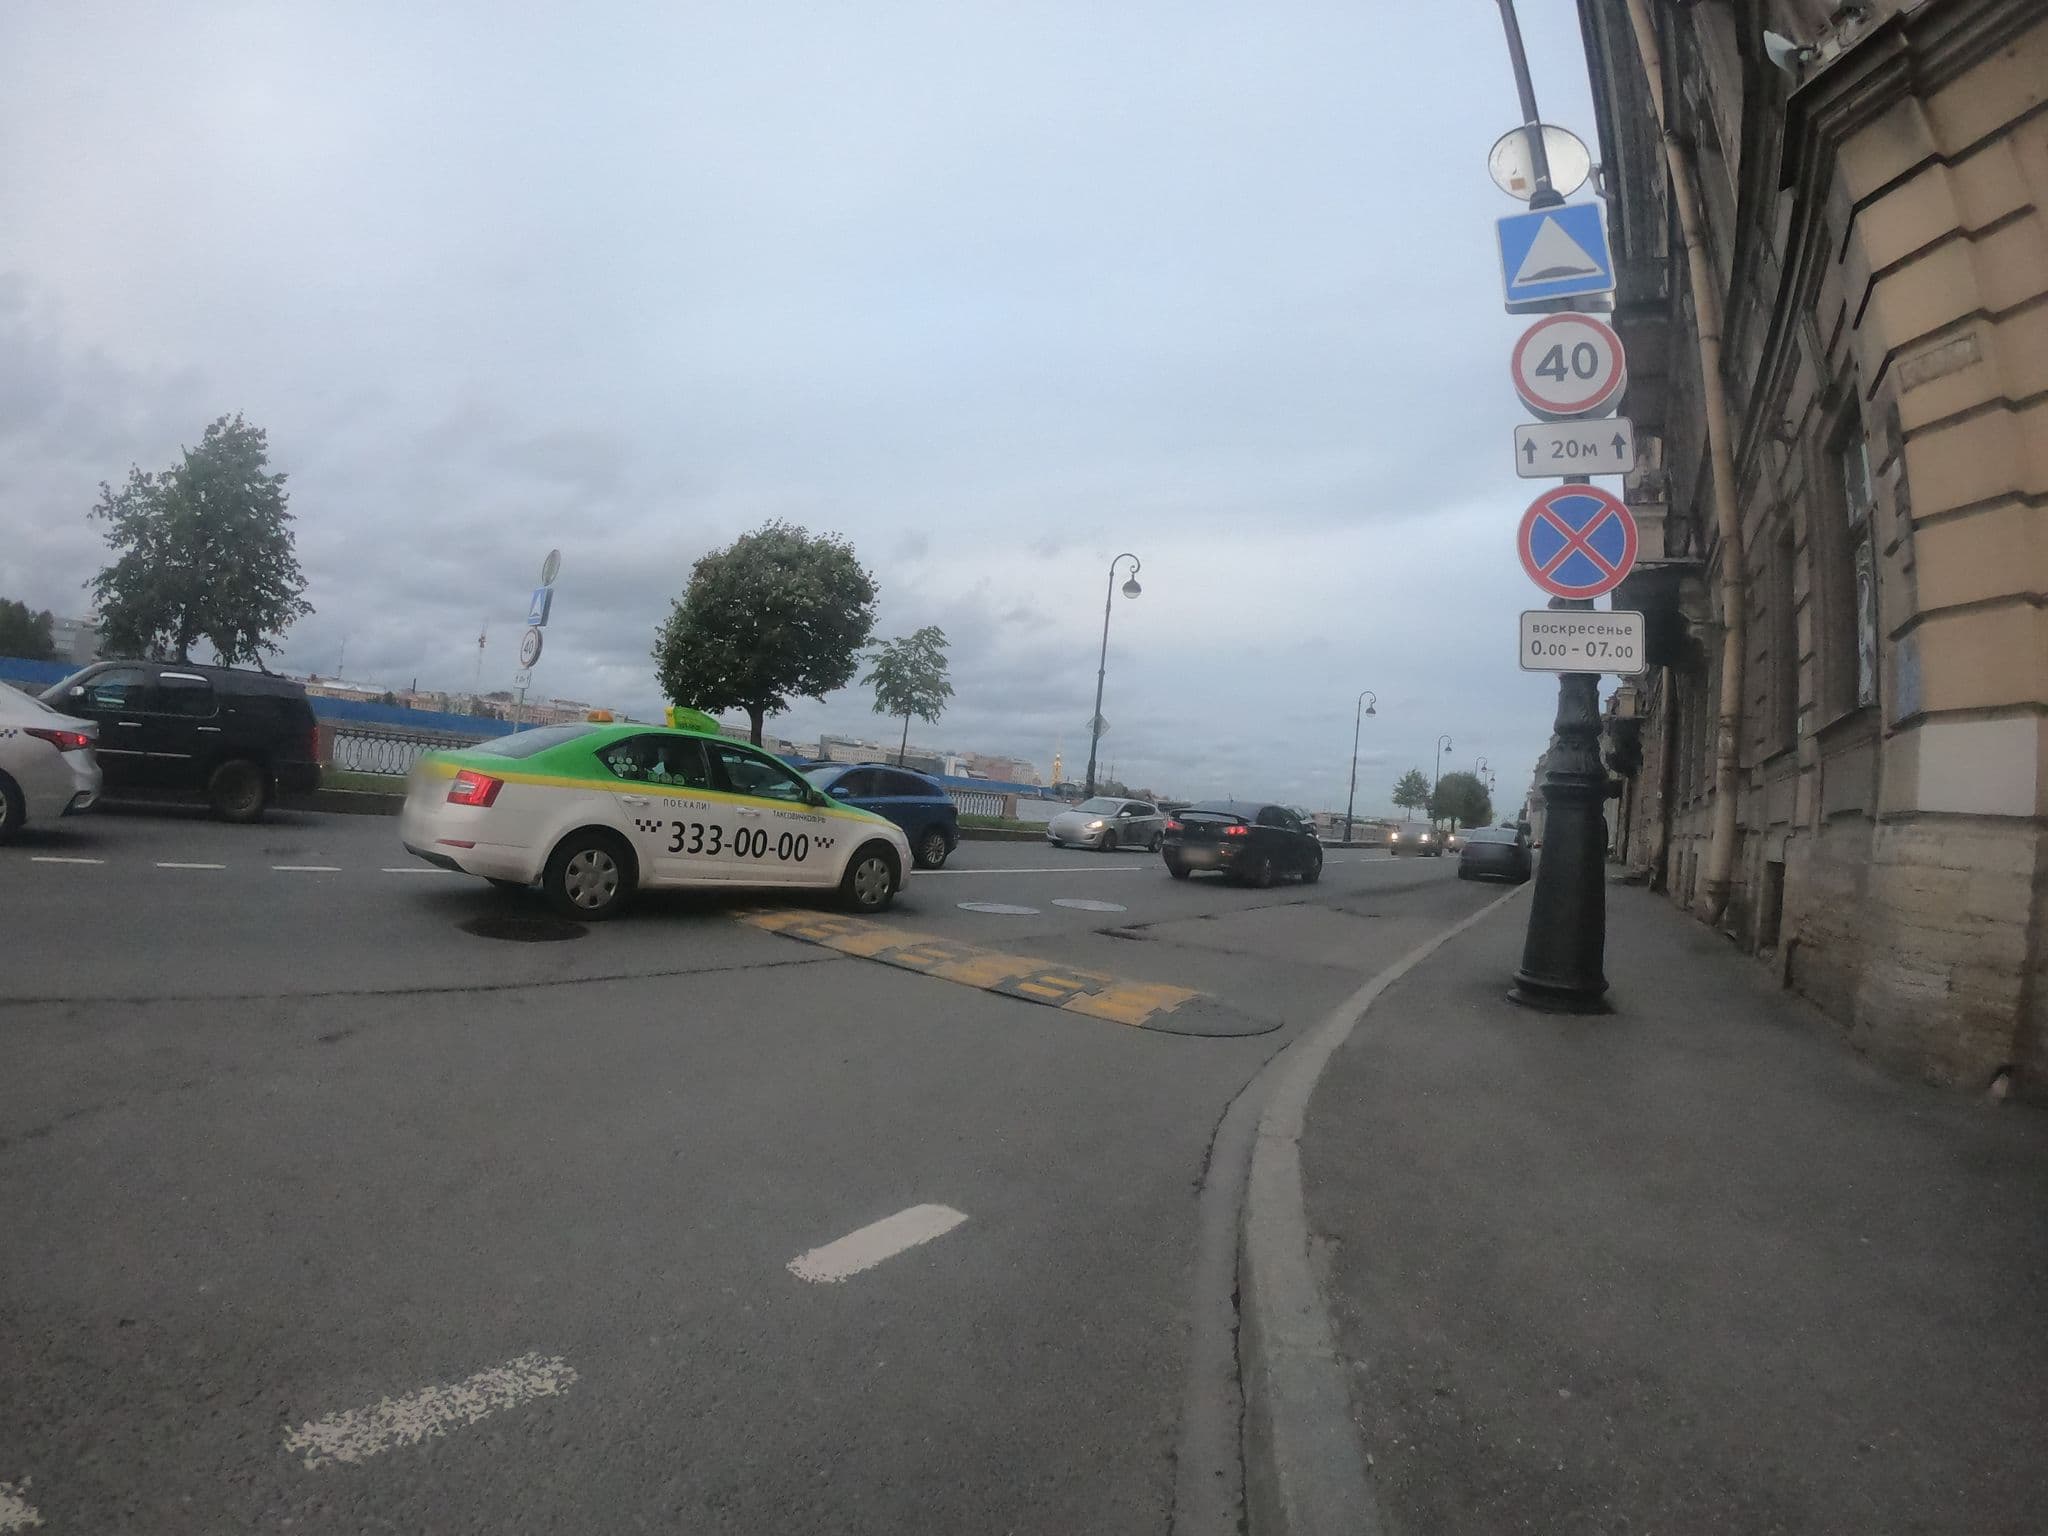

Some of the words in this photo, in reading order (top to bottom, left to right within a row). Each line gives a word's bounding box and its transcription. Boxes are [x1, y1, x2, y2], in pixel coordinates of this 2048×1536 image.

[1535, 342, 1599, 382] 40
[1532, 624, 1633, 636] воскресенье
[523, 639, 534, 654] 40
[663, 798, 711, 811] ПОЕХАЛИ!
[668, 821, 809, 862] 333-00-00
